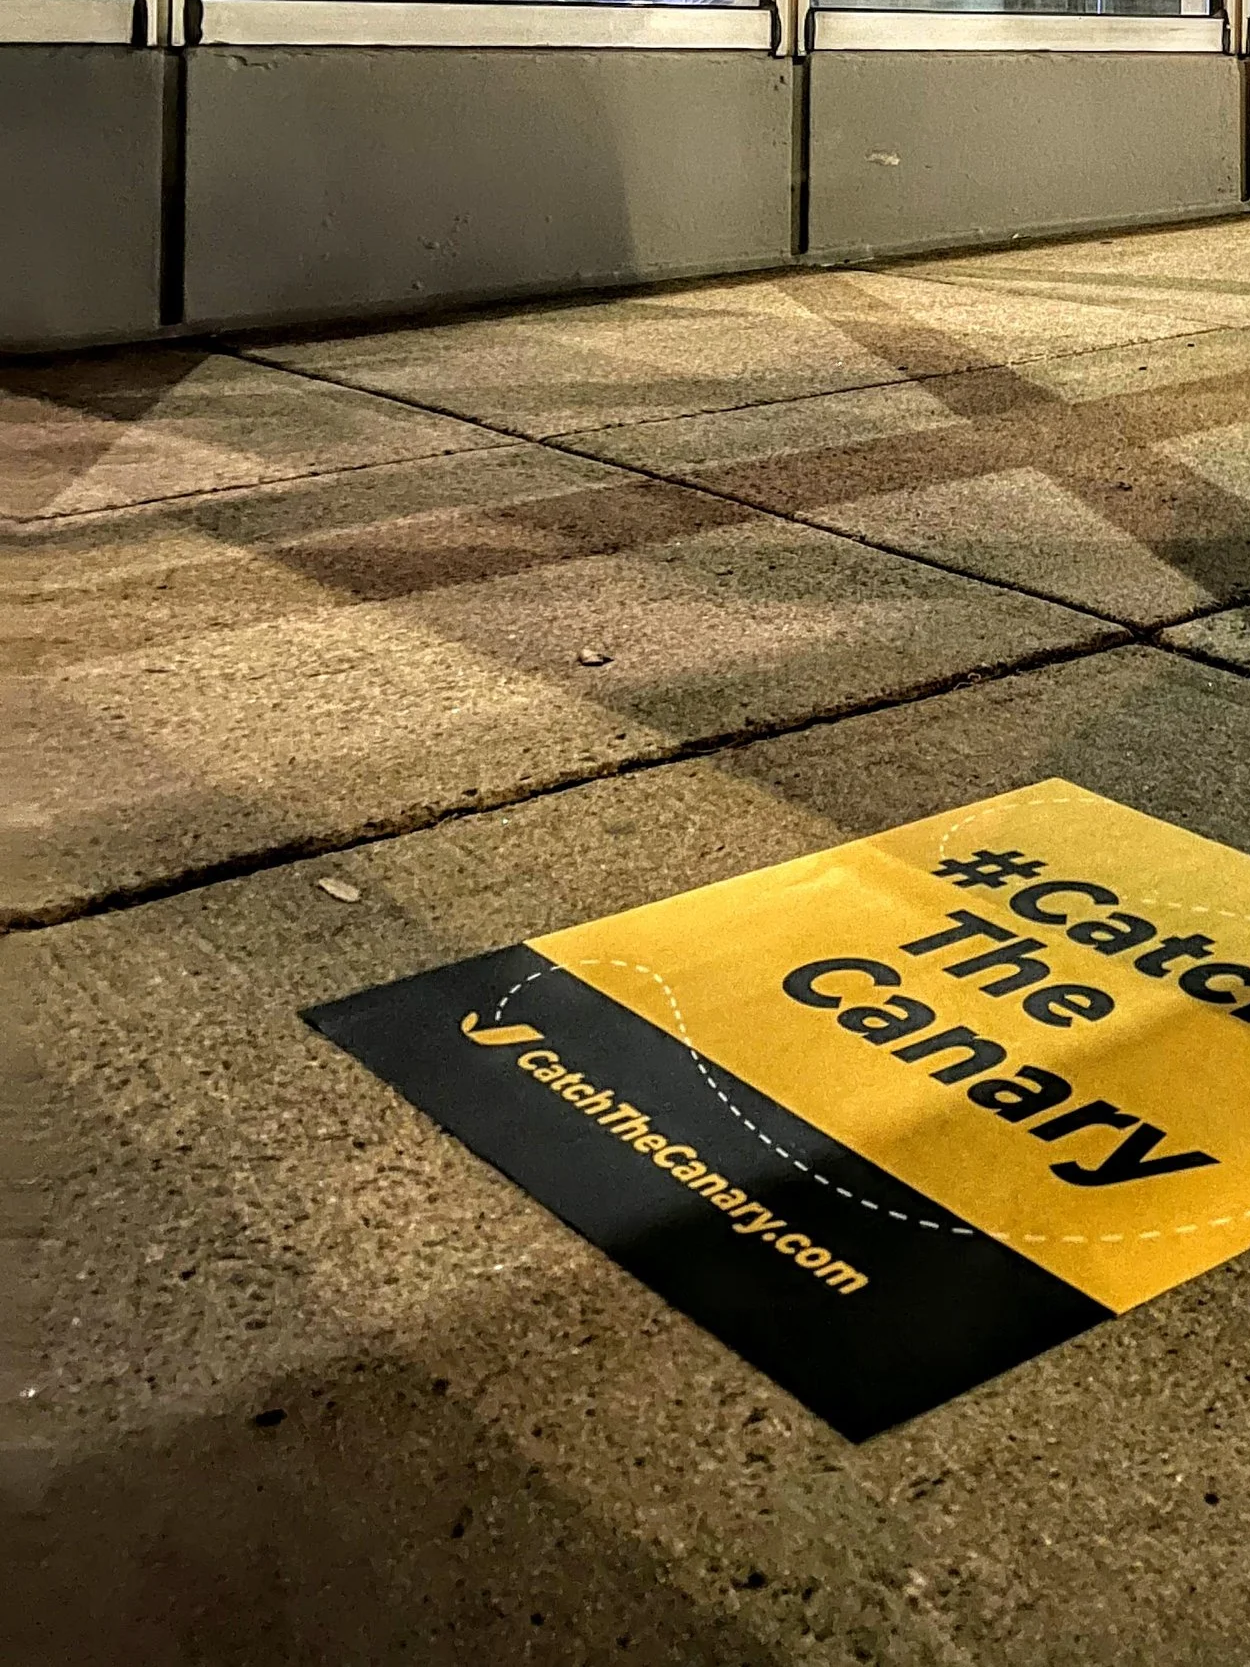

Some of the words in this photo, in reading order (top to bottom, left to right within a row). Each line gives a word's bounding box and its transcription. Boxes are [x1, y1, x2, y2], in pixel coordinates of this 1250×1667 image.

[781, 956, 1222, 1188] Canary
[899, 908, 1116, 1028] The
[517, 1049, 870, 1295] CatchTheCanary.com
